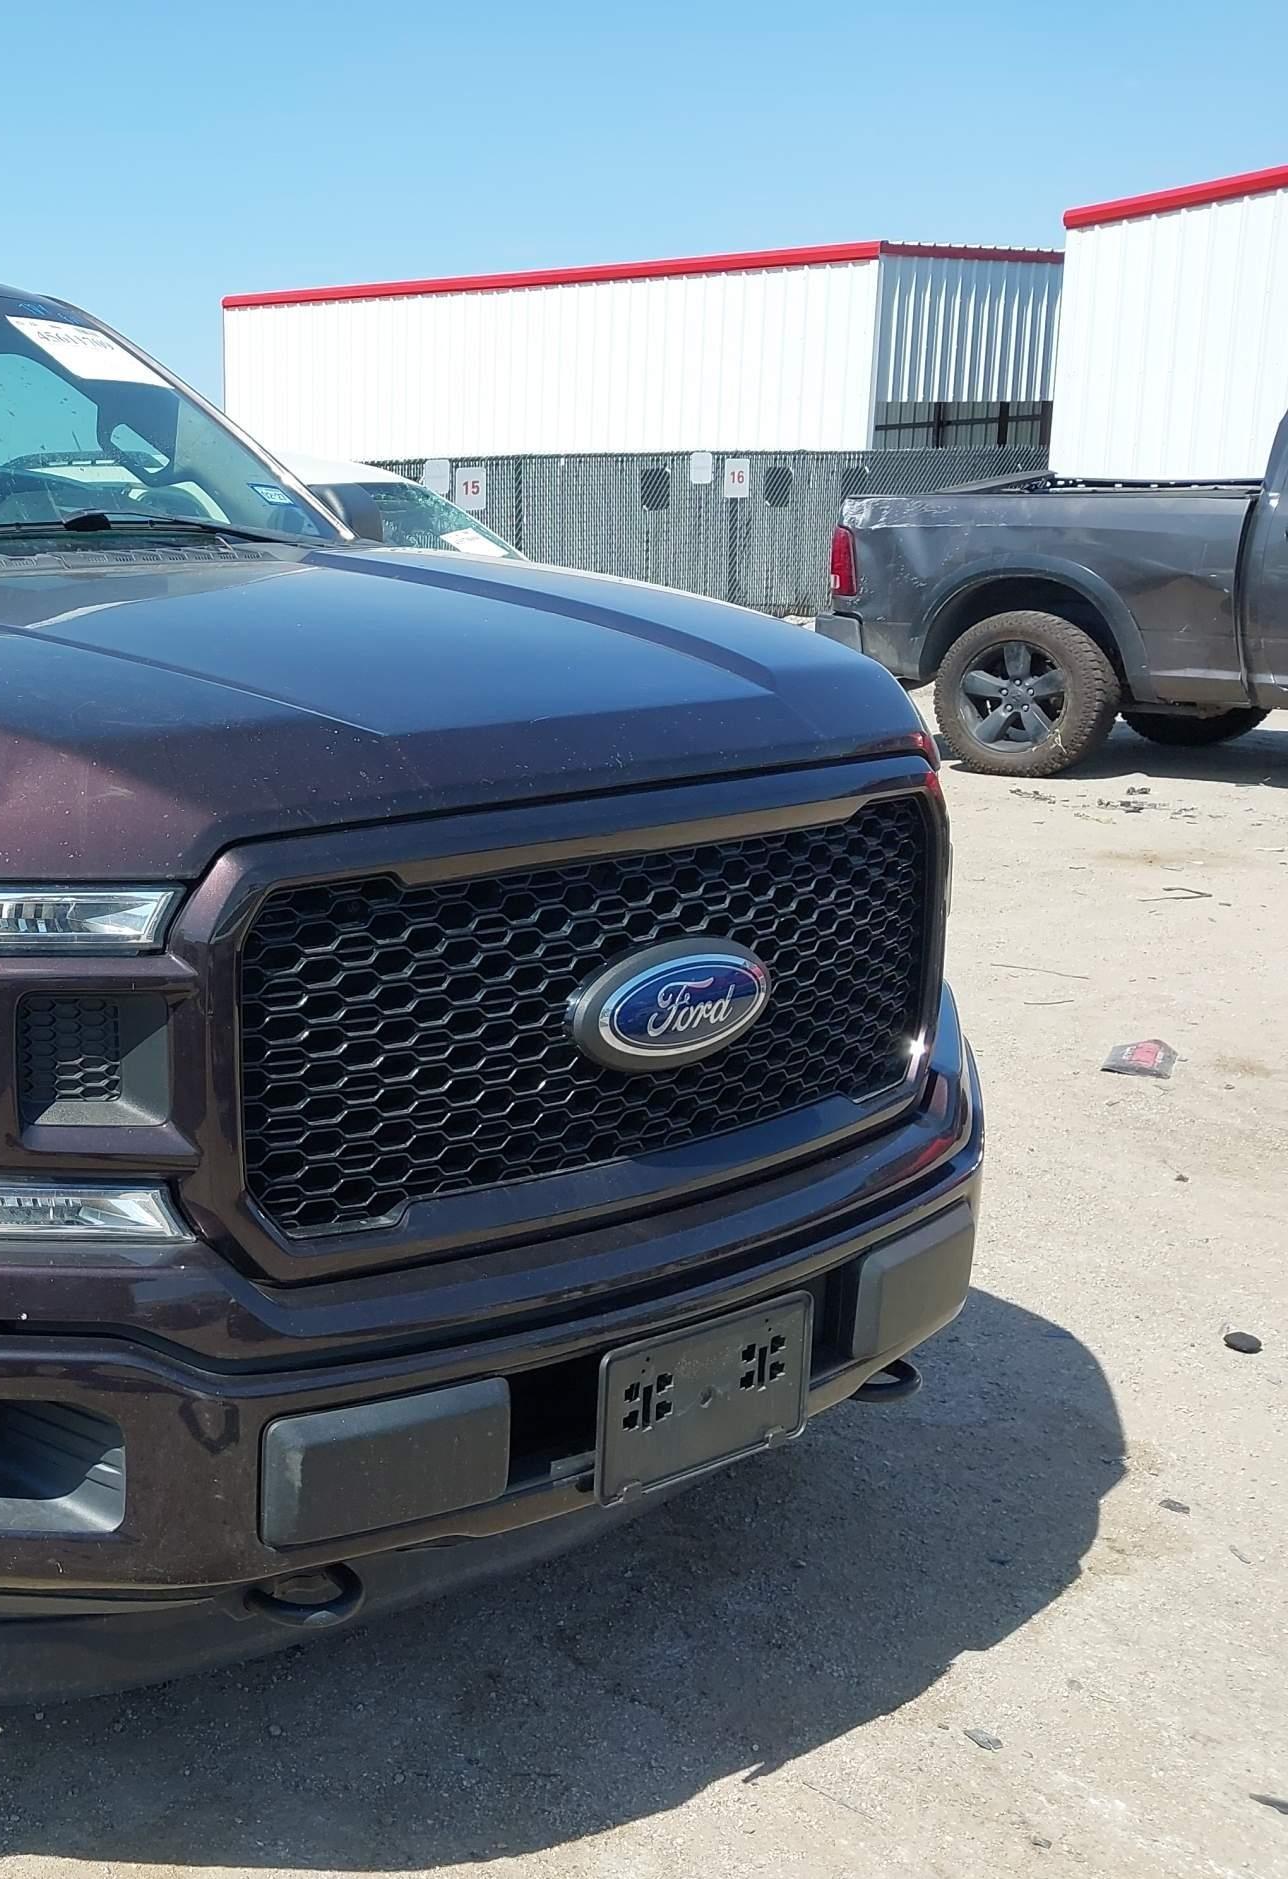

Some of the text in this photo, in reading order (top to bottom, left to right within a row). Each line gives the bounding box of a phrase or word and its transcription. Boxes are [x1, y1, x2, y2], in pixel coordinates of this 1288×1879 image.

[730, 470, 745, 484] 16
[462, 480, 480, 496] 15
[647, 977, 735, 1037] Ford
